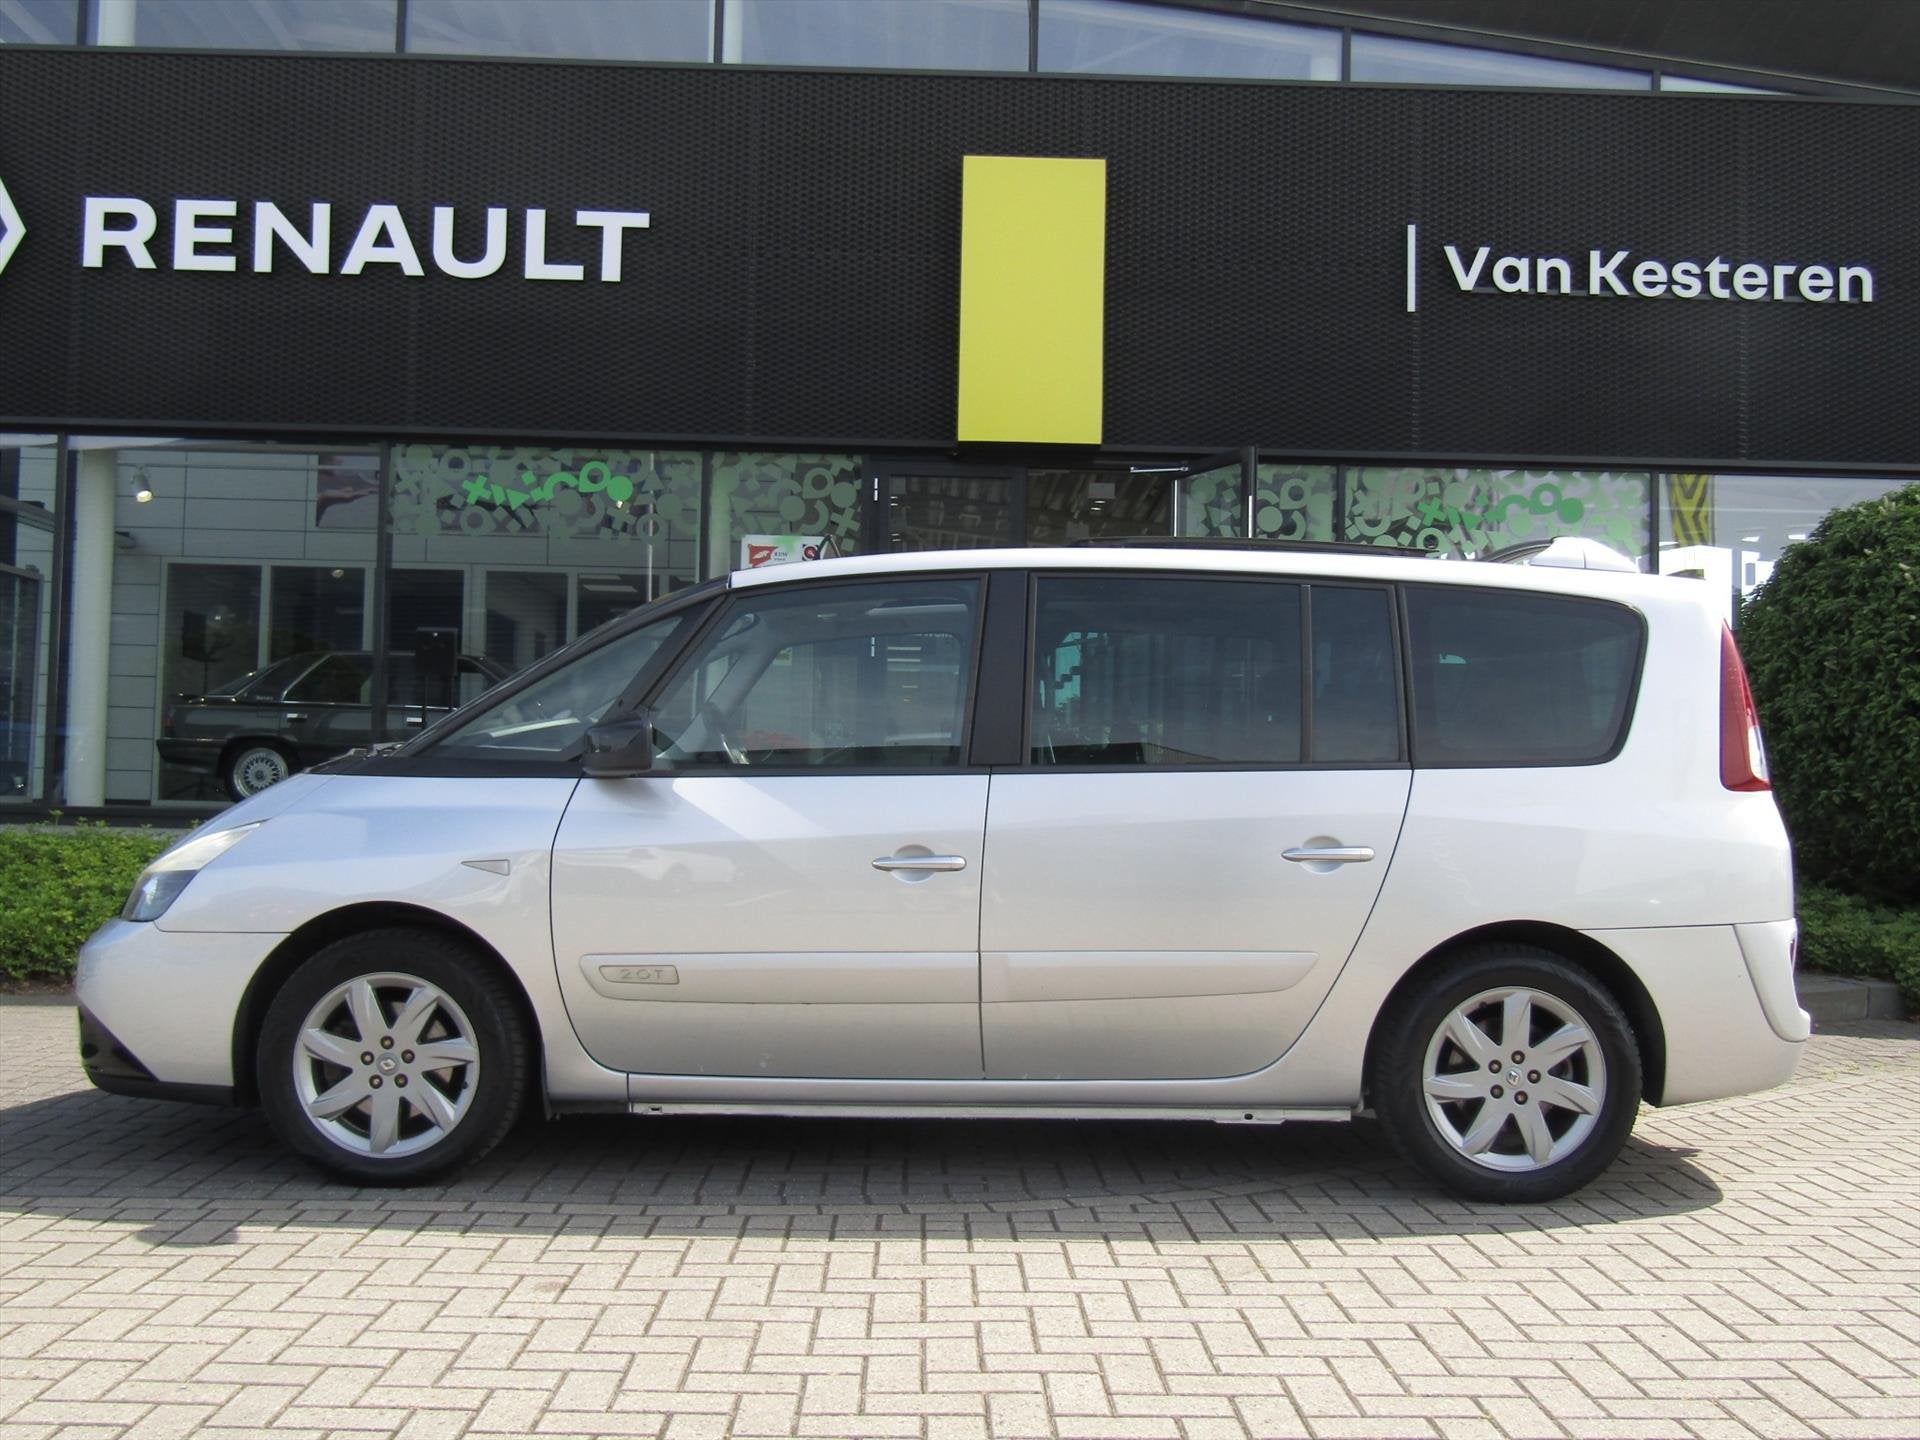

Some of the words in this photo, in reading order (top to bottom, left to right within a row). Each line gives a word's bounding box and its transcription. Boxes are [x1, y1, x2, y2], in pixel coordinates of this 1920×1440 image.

[82, 196, 650, 282] RENAULT
[1443, 245, 1571, 294] Van
[1589, 250, 1873, 302] Kesteren
